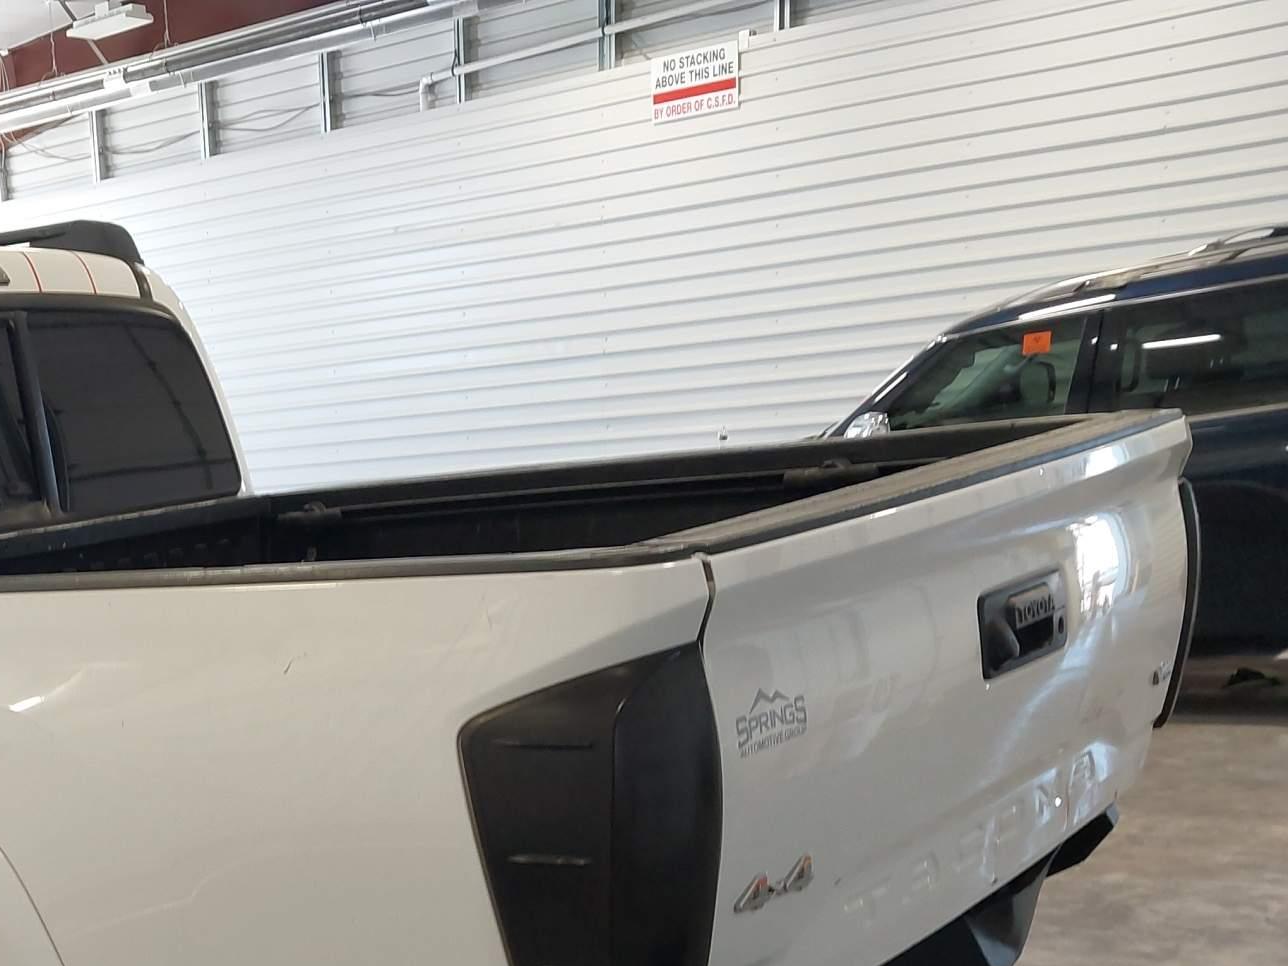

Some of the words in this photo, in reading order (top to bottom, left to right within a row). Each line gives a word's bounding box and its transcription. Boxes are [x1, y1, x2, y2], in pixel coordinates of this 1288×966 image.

[655, 73, 686, 90] ABOVE
[689, 66, 710, 82] THIS
[713, 60, 734, 76] LINE
[663, 58, 677, 73] NO
[679, 48, 726, 69] STACKING
[654, 107, 664, 120] BY
[666, 101, 692, 118] ORDER
[694, 98, 705, 112] OF
[707, 93, 736, 110] C.S.F.D.
[1015, 593, 1055, 626] TOYOTA
[735, 694, 808, 750] SPRINGS
